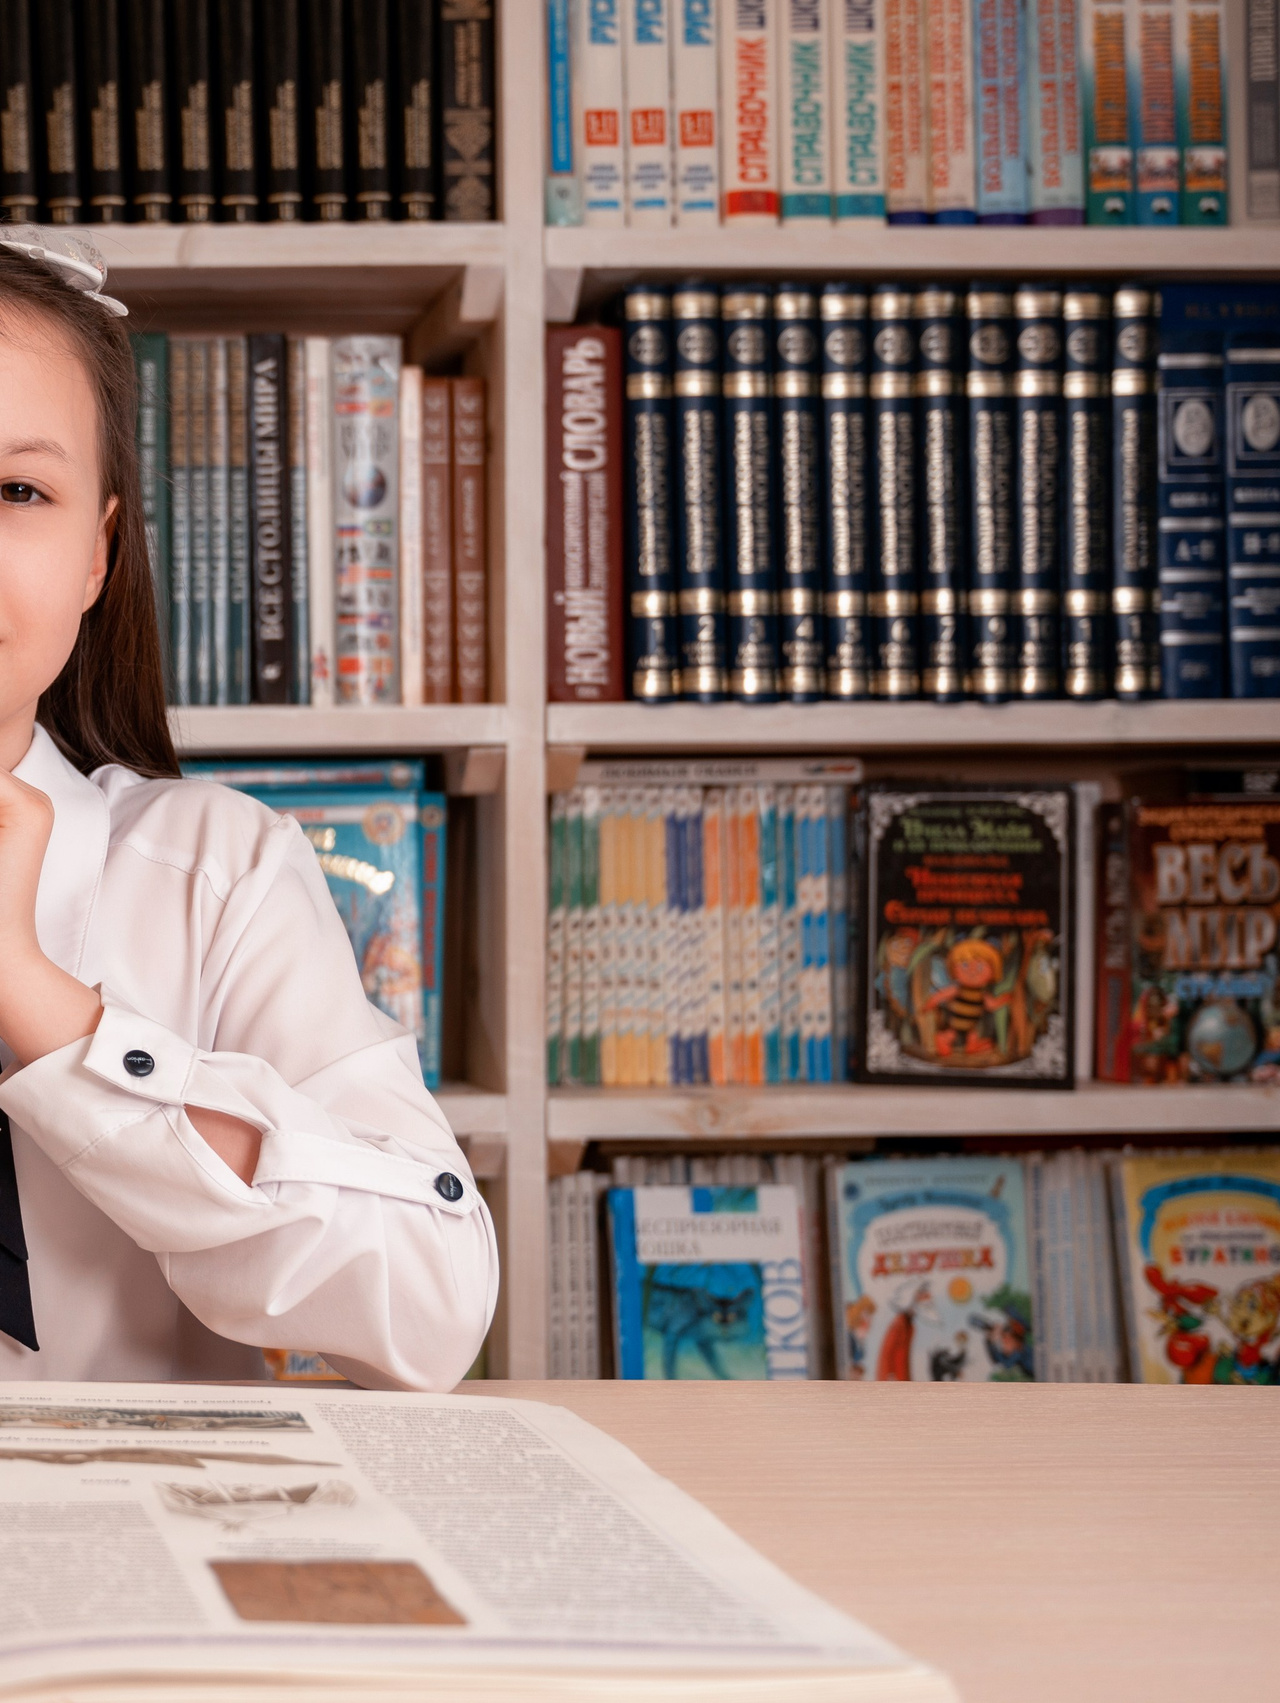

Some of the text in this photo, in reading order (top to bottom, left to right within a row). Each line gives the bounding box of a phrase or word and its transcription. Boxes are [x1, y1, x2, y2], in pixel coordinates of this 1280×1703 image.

[736, 0, 768, 183] СПРАВОЧНИК ШК
[792, 40, 823, 186] СПРАВОЧНИК
[846, 40, 878, 186] СПРАВОЧНИК
[561, 337, 607, 471] СЛОВАРЬ
[253, 358, 285, 641] ВСЕ СТОЛИЦЫ МИРА
[555, 590, 609, 686] НОВЫЙ
[698, 616, 715, 642] 2
[796, 617, 813, 641] 4
[940, 617, 956, 642] 7
[1152, 842, 1280, 905] ВЕСЬ
[1163, 907, 1277, 970] МИР
[871, 1245, 994, 1279] ДЕДУШКА
[1169, 1246, 1280, 1265] БУРАТИНО
